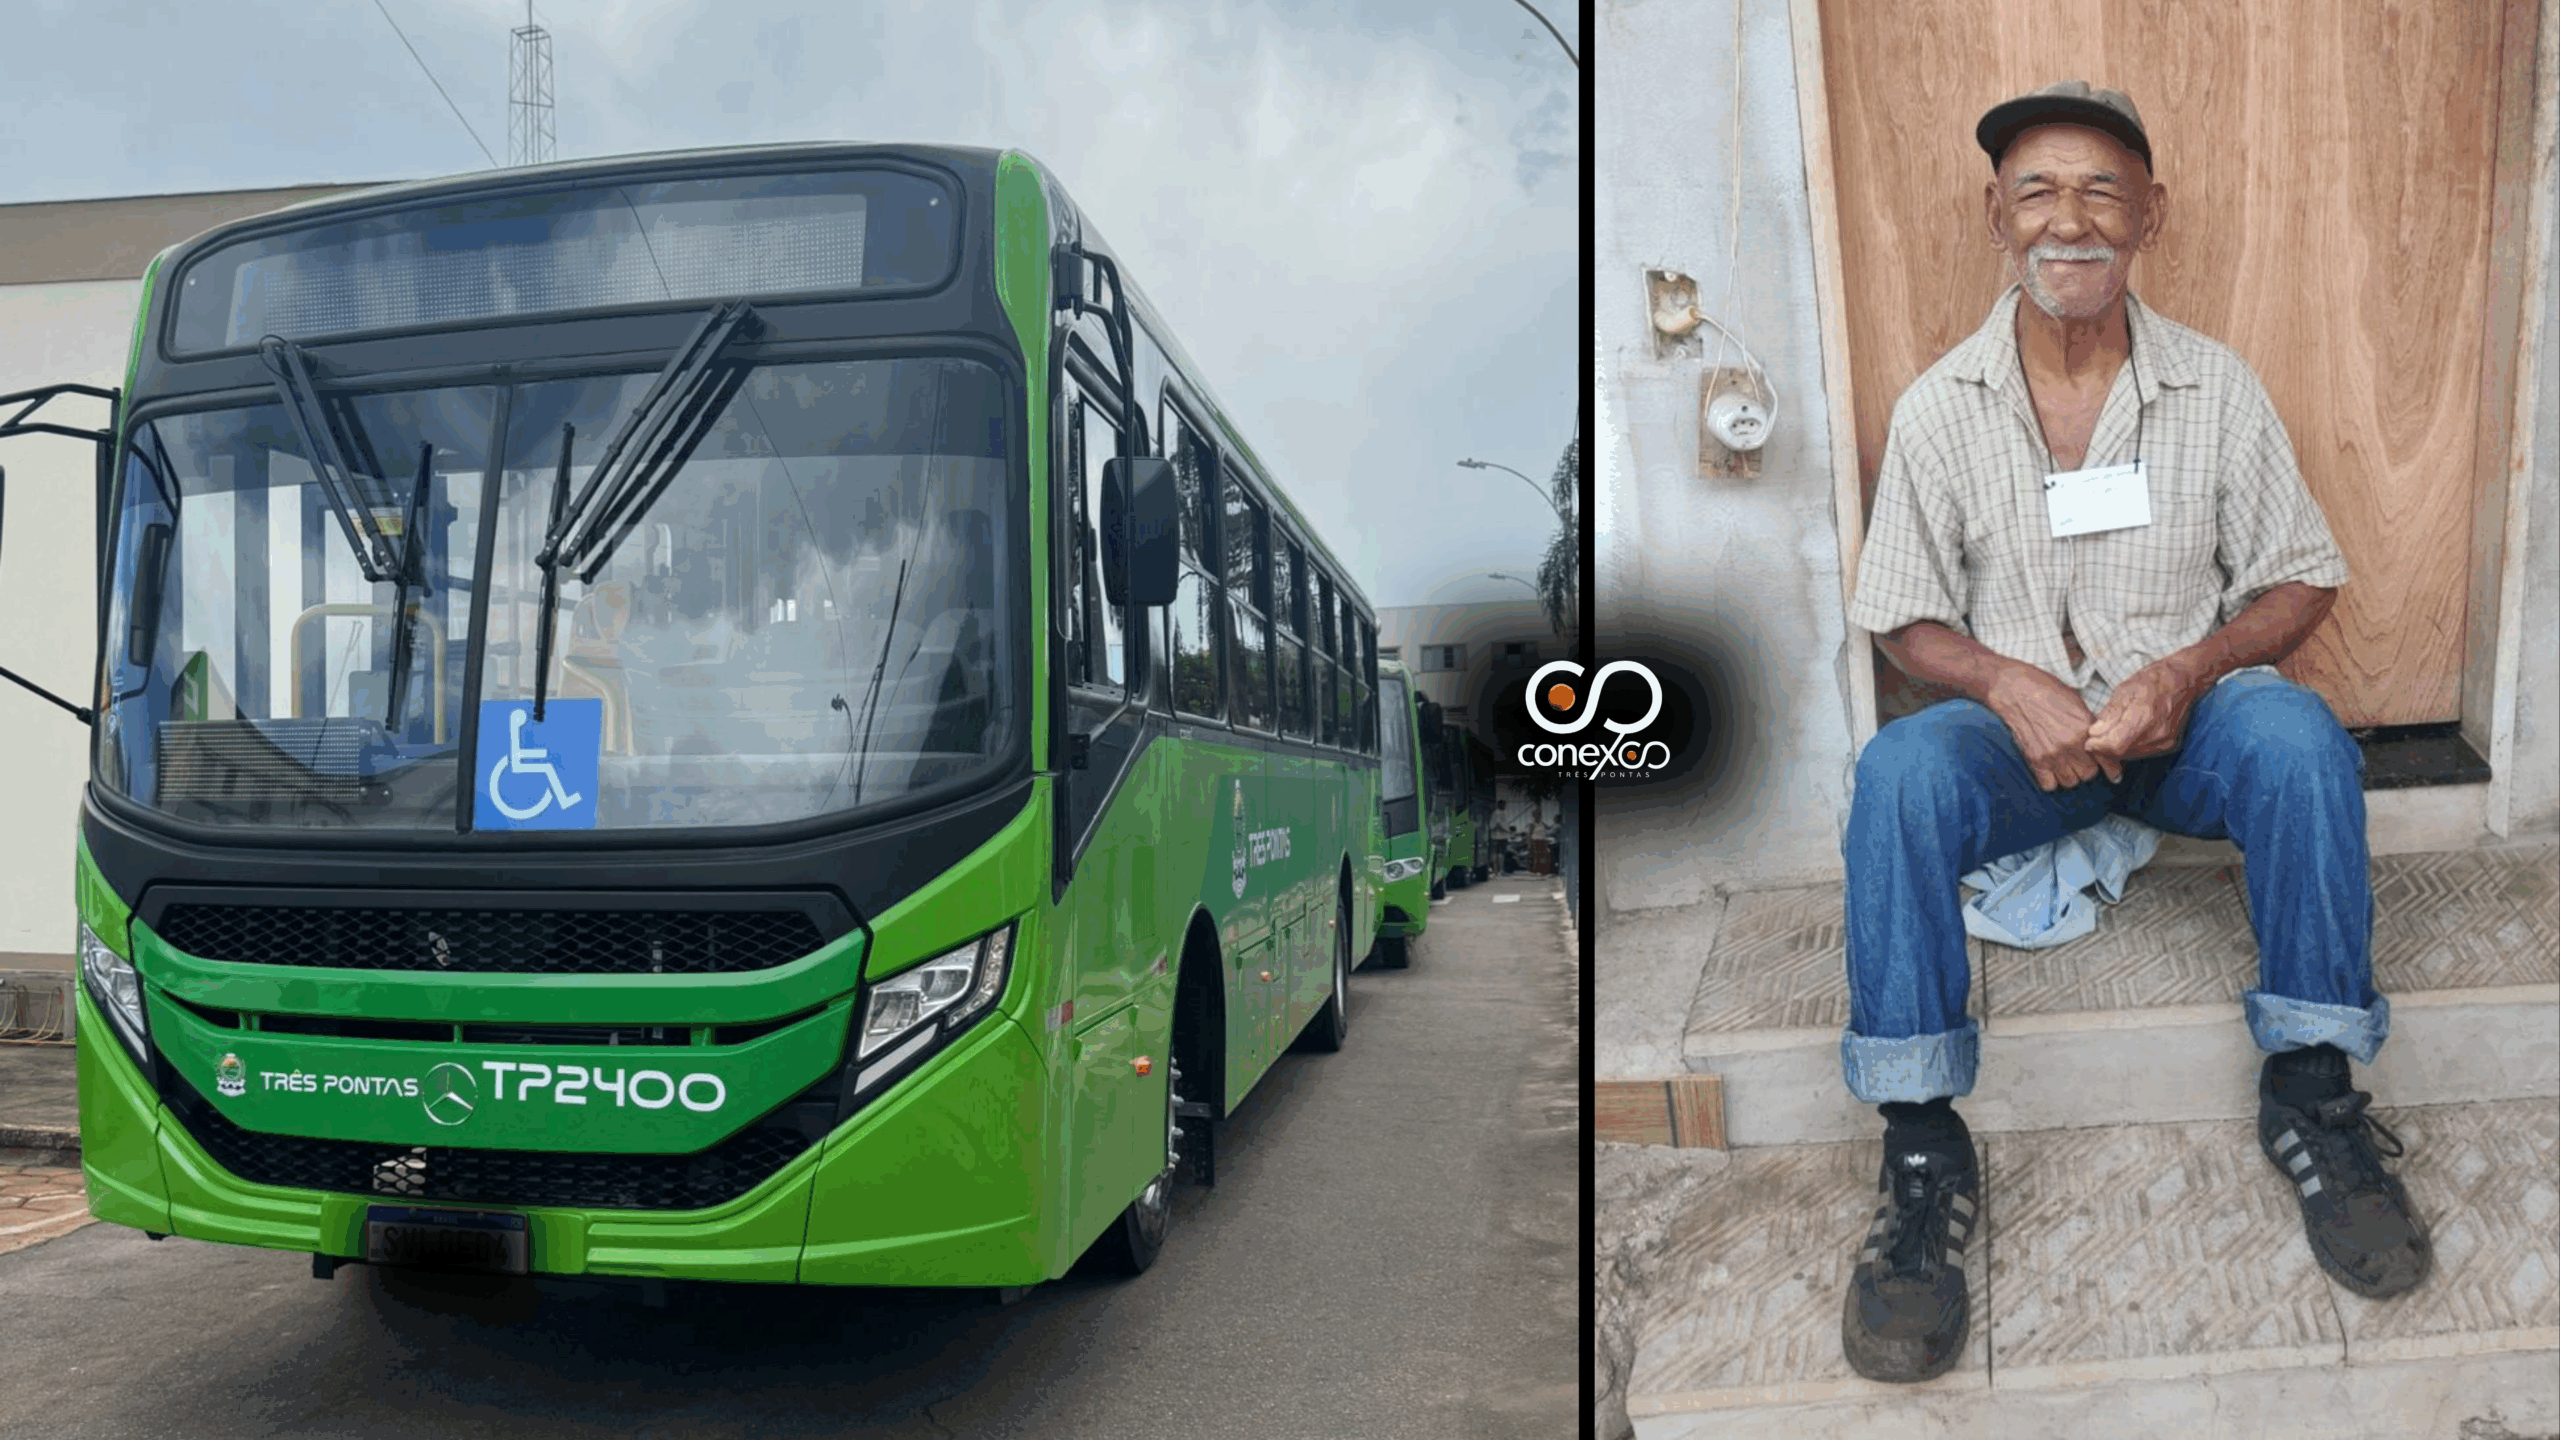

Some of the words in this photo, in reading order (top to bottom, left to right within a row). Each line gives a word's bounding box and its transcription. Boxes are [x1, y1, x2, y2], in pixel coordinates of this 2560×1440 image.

[259, 1068, 318, 1093] TRÊS
[323, 1074, 419, 1097] PONTAS
[482, 1060, 726, 1112] TP2400
